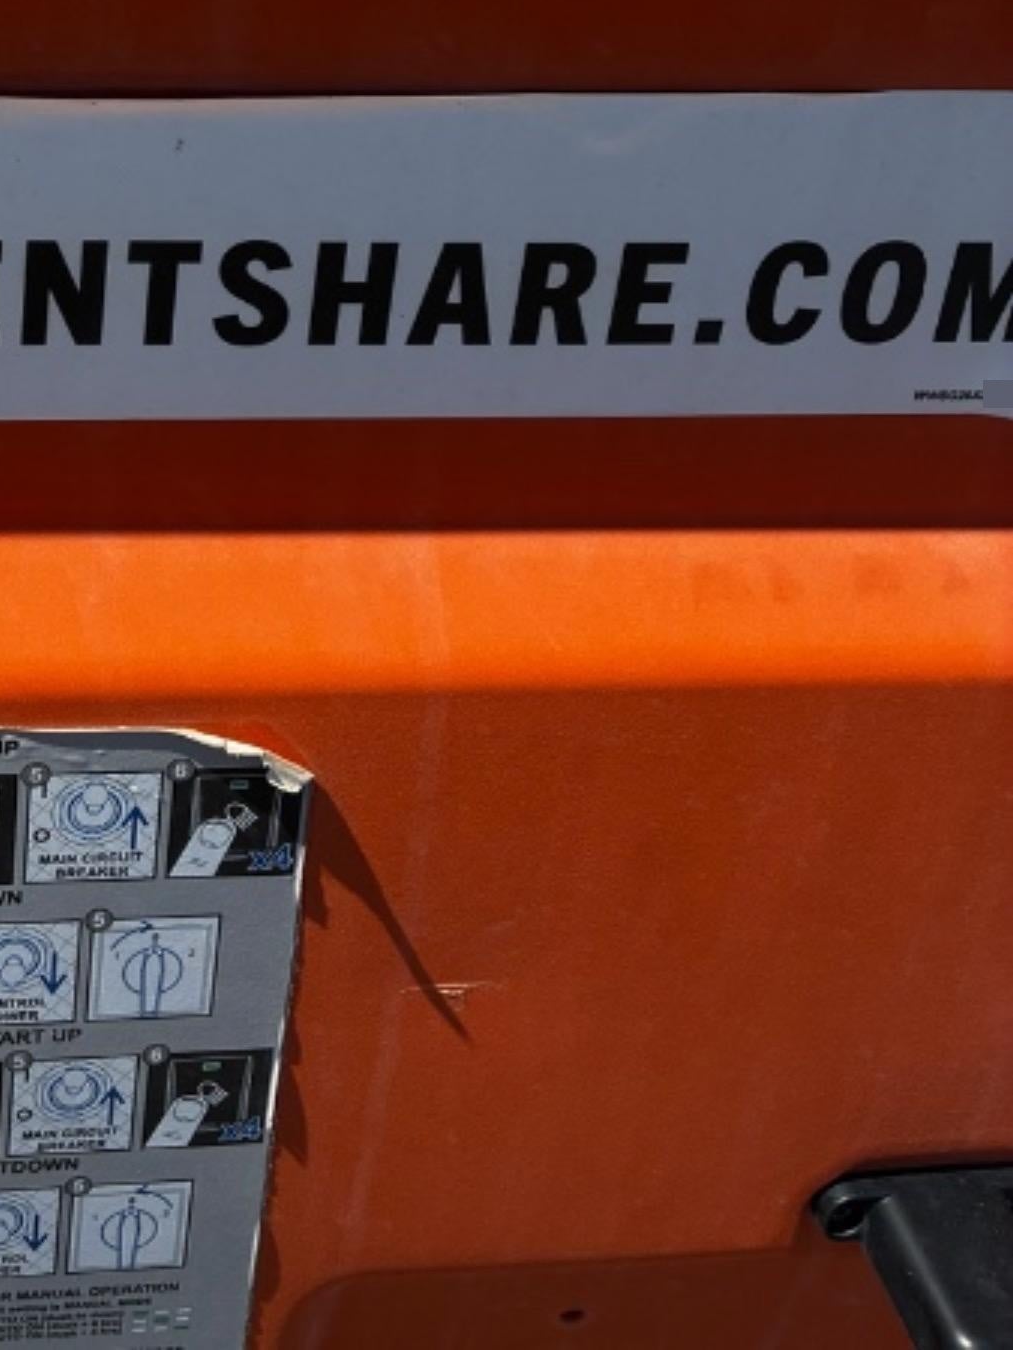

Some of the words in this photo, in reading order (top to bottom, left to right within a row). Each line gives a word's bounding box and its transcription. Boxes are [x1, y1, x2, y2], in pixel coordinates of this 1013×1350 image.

[39, 853, 77, 865] MAIN
[81, 851, 144, 864] CIRCUIT
[55, 867, 130, 879] BREAKER
[52, 1028, 82, 1043] UP
[22, 1129, 57, 1140] MAIN
[61, 1127, 118, 1138] CIRCUIT
